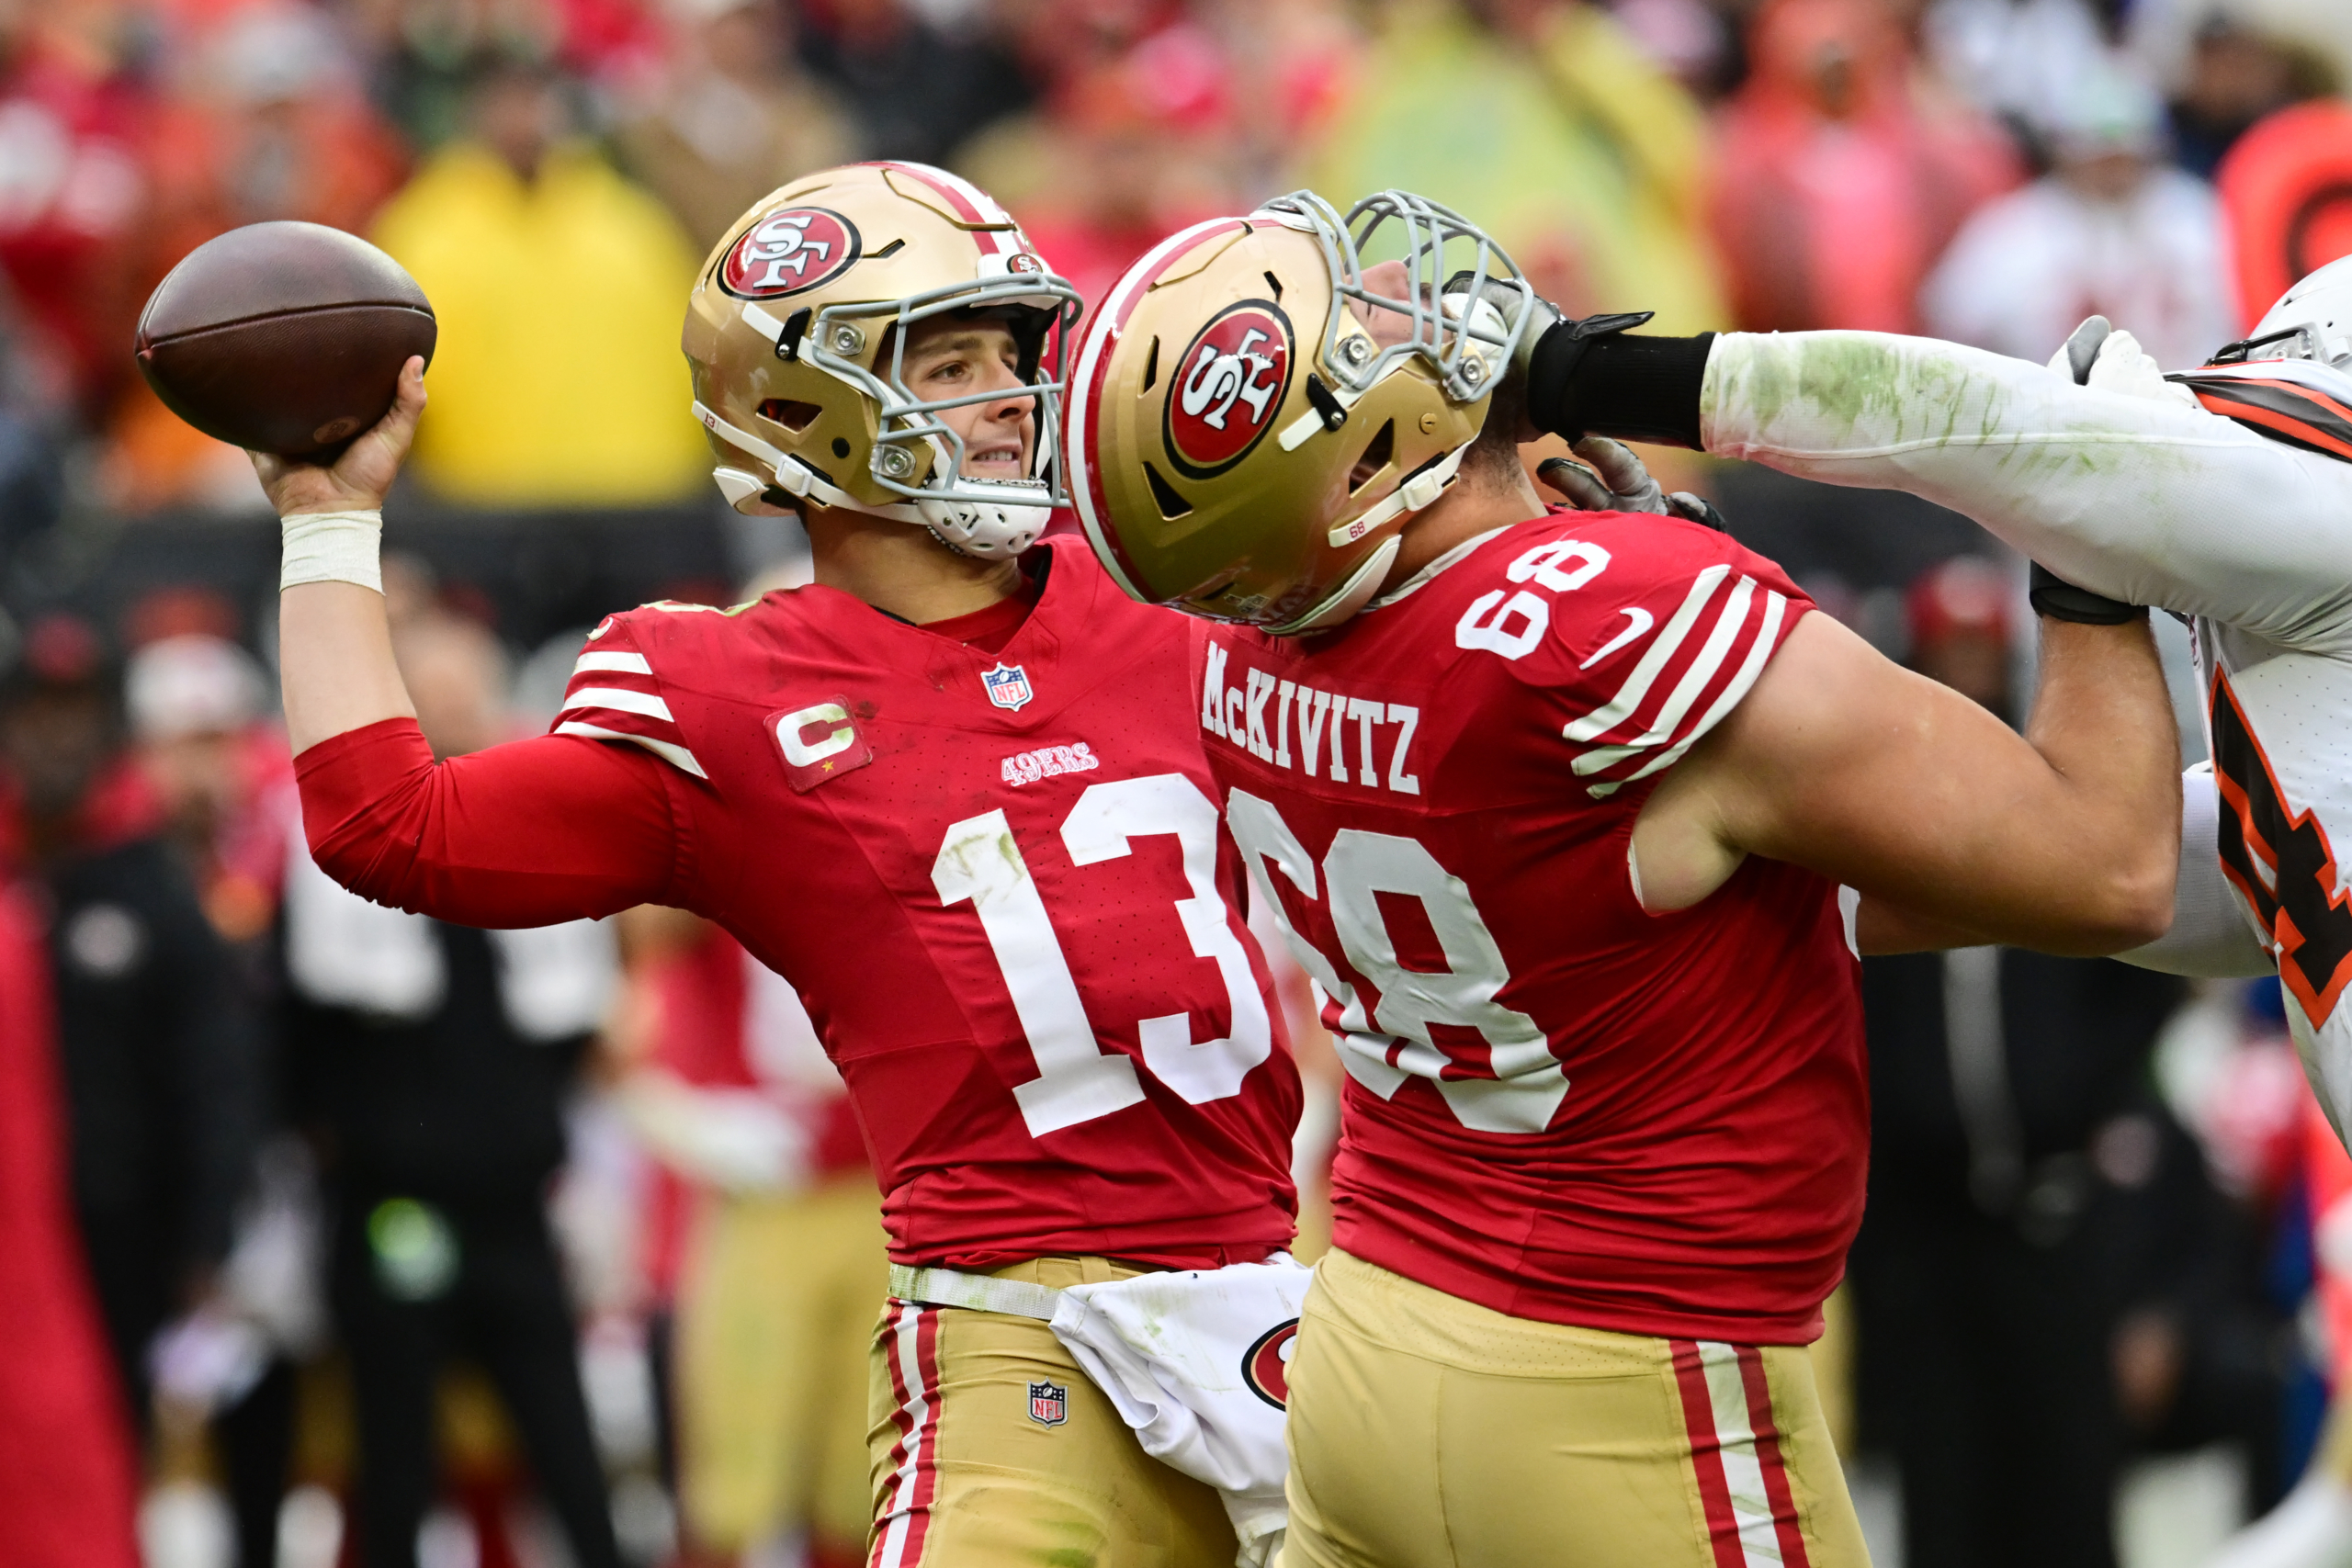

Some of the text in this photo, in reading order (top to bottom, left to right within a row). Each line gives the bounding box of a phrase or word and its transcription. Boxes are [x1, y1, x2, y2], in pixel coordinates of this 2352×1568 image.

[745, 216, 831, 289] SF
[1182, 327, 1280, 431] SF
[704, 412, 716, 429] 13
[1349, 521, 1365, 538] 68
[1455, 539, 1611, 661] 68
[993, 682, 1027, 703] NFL
[1201, 640, 1420, 795] McKIVITZ
[775, 702, 856, 768] C
[1001, 741, 1100, 787] 49ERS
[930, 773, 1272, 1139] 13
[1226, 786, 1570, 1134] 68
[1034, 1398, 1063, 1420] NFL
